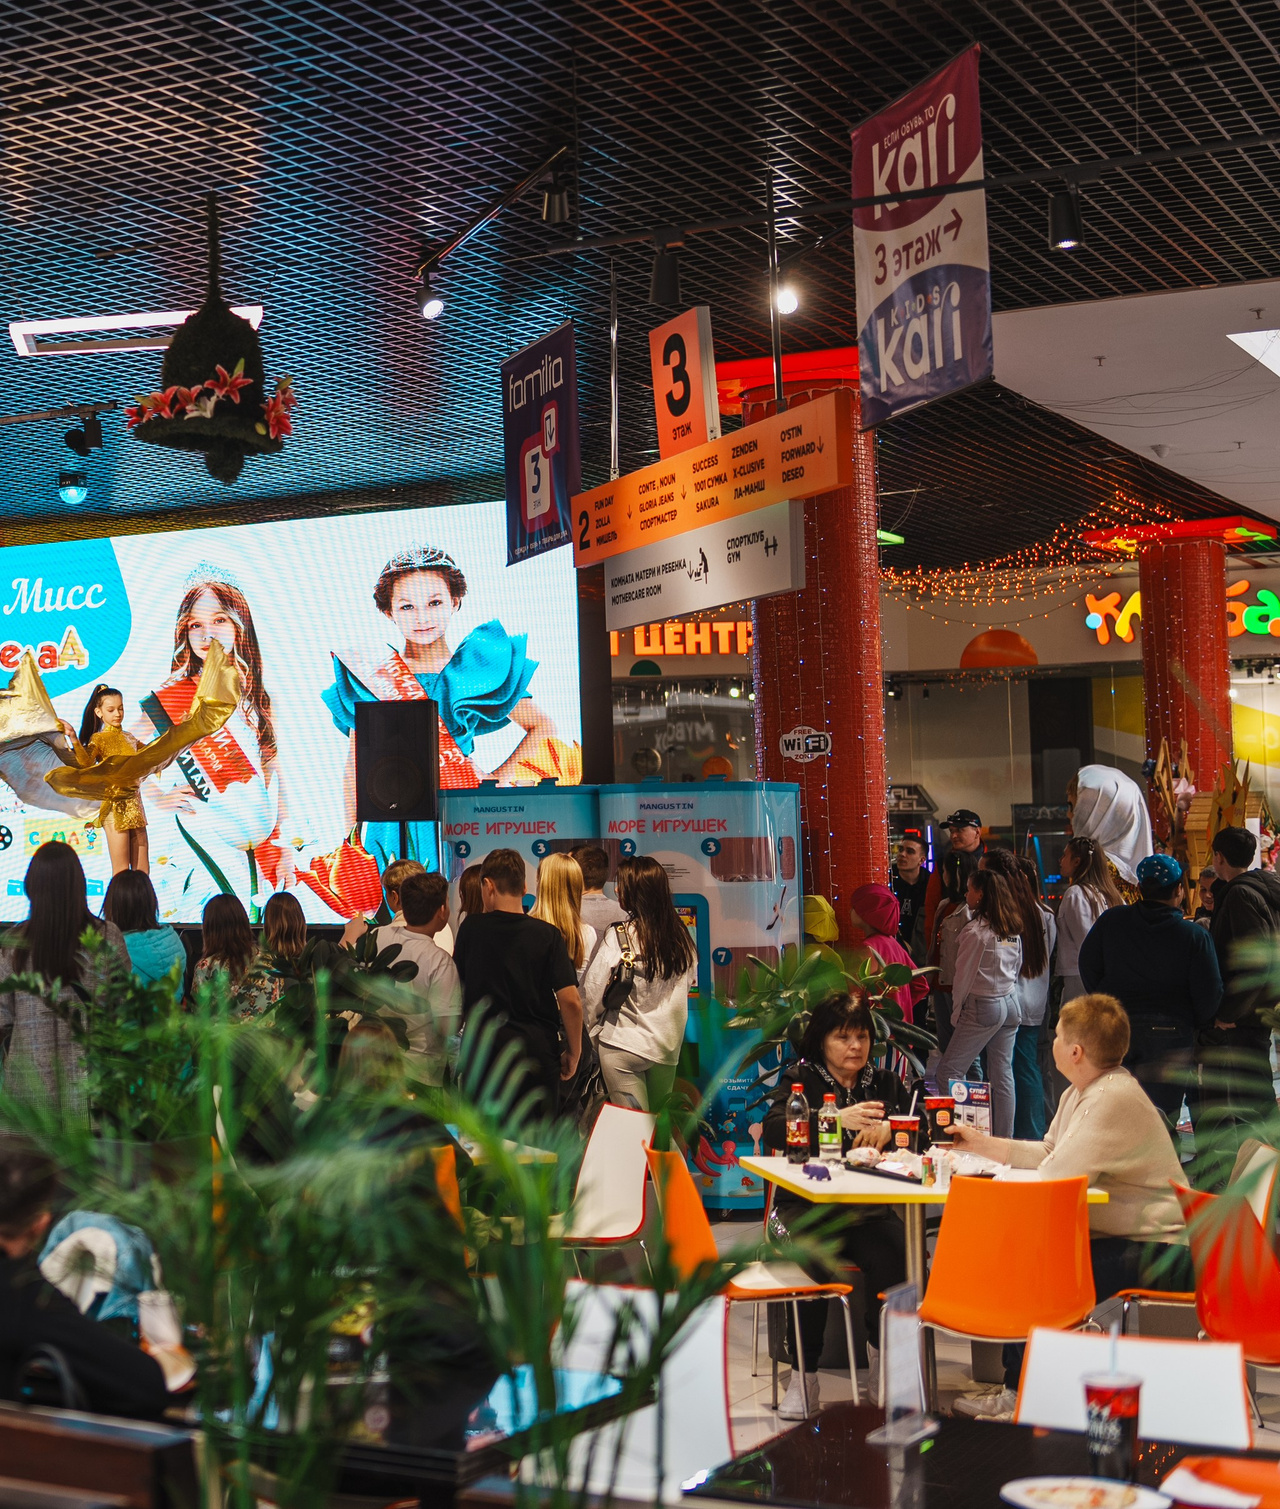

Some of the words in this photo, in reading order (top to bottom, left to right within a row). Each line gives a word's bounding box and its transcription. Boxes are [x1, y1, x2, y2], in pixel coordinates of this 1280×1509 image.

[884, 132, 900, 149] ЕСЛИ
[924, 105, 935, 121] ТО
[872, 93, 956, 221] kari
[874, 243, 888, 286] 3
[892, 225, 942, 277] этаж
[877, 281, 963, 394] kari
[509, 354, 564, 413] familia
[663, 333, 691, 417] 3
[672, 421, 692, 440] этаж
[731, 439, 758, 459] ZENDEN
[781, 441, 816, 463] FORWARD
[531, 452, 541, 494] 3
[692, 455, 719, 474] SUCCESS
[733, 458, 765, 479] X-CLUSIVE
[782, 466, 805, 483] DESEO
[660, 473, 676, 487] NOUN
[694, 479, 707, 493] 1001
[707, 472, 728, 489] СУМКА
[734, 480, 765, 500] ЛА-МАНШ
[595, 499, 604, 511] FUN
[604, 495, 614, 507] DAY
[639, 499, 658, 513] GLORIA
[658, 492, 675, 506] JEANS
[696, 496, 720, 513] SAKURA
[596, 515, 611, 529] ZOLLA
[640, 509, 678, 531] СПОРТМАСТЕР
[579, 510, 591, 551] 2
[596, 531, 617, 546] МИШЕЛЬ
[727, 530, 765, 550] СПОРТКЛУБ
[727, 551, 741, 564] GYM
[611, 573, 635, 589] КОМНАТА
[635, 569, 656, 584] МАТЕРИ
[661, 558, 687, 575] РЕБЕНКА
[3, 577, 107, 615] Мисс
[611, 588, 645, 606] MOTHERCARE
[645, 584, 662, 598] ROOM
[634, 621, 753, 656] ЦЕНТР
[473, 805, 525, 813] MANGUSTIN
[445, 822, 480, 836] МОРЕ
[486, 820, 557, 835] ИГРУШЕК
[608, 819, 646, 834] МОРЕ
[652, 818, 728, 833] ИГРУШЕК
[459, 844, 467, 854] 2
[537, 843, 546, 854] 3
[624, 842, 632, 853] 2
[707, 841, 716, 853] 3
[717, 951, 726, 962] 7
